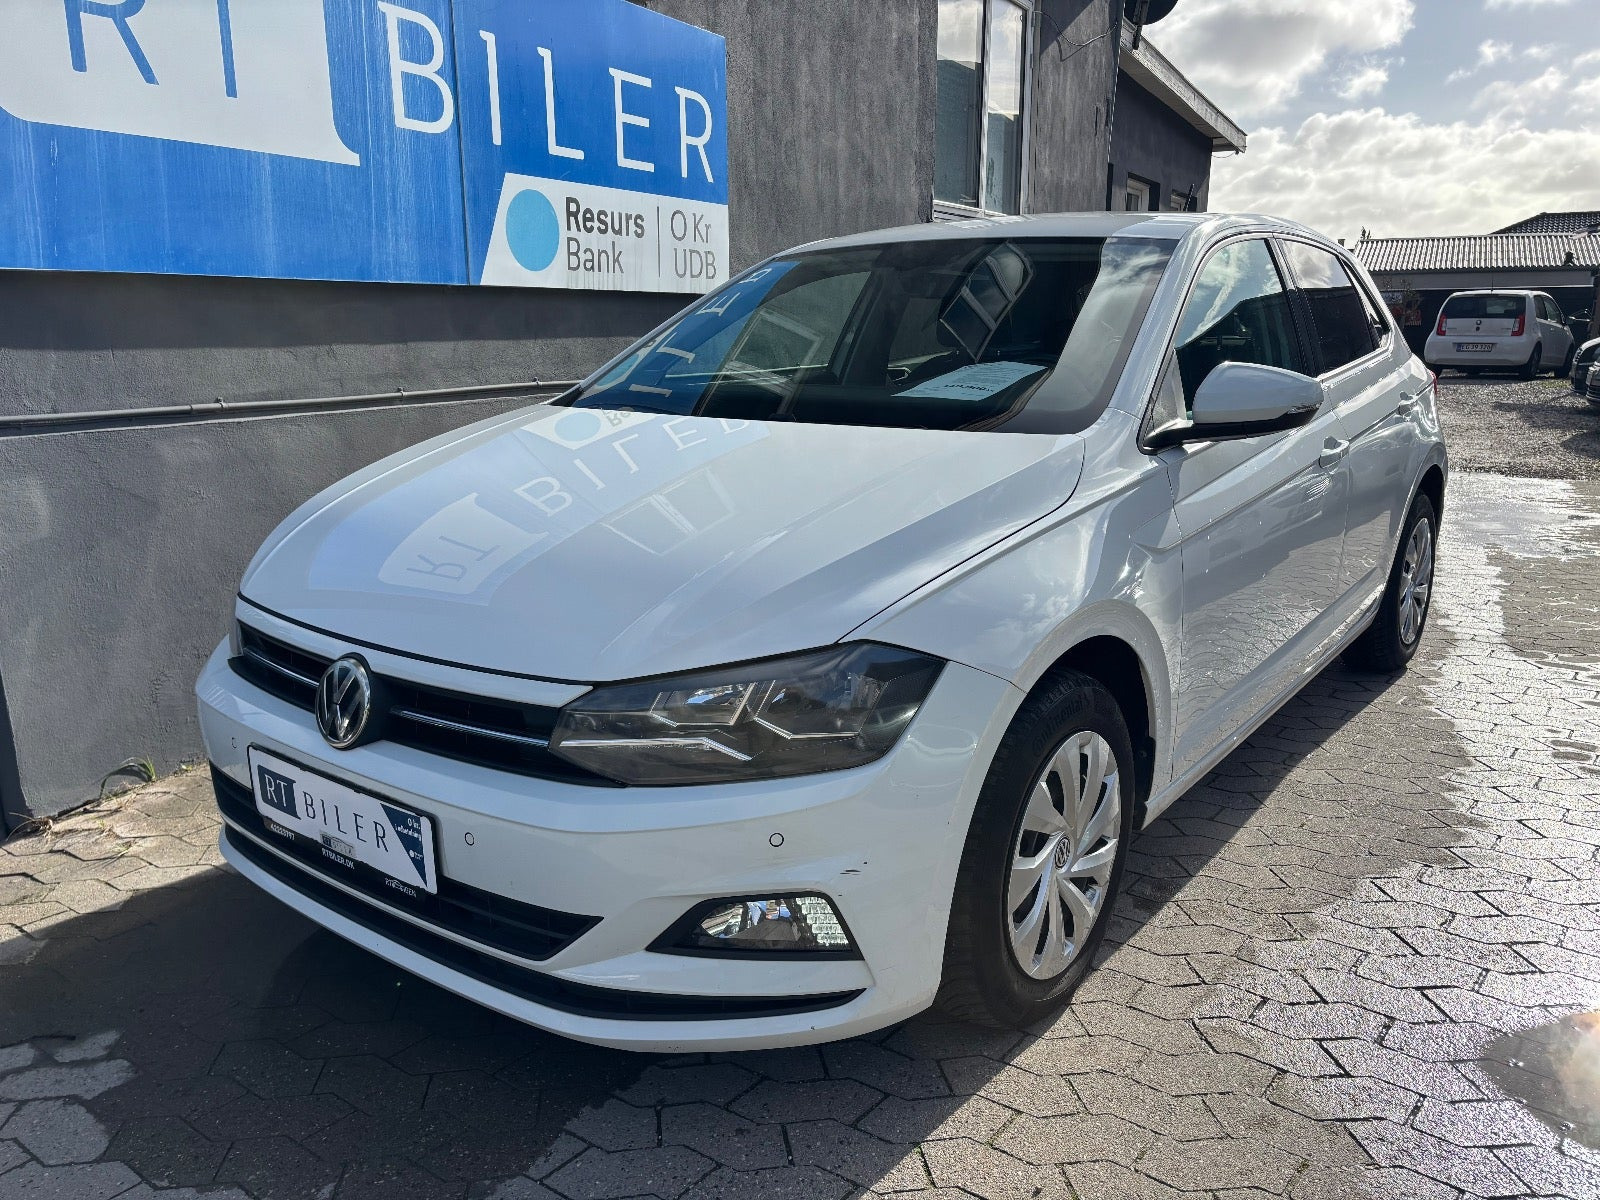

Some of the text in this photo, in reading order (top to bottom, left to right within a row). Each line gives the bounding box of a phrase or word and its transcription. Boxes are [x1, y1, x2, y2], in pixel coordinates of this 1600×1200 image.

[378, 0, 714, 183] BILER
[565, 196, 646, 239] Resurs
[692, 212, 712, 244] Kr
[566, 236, 625, 275] Bank
[674, 247, 717, 280] UDB
[263, 774, 288, 808] RT
[302, 790, 389, 853] BILER
